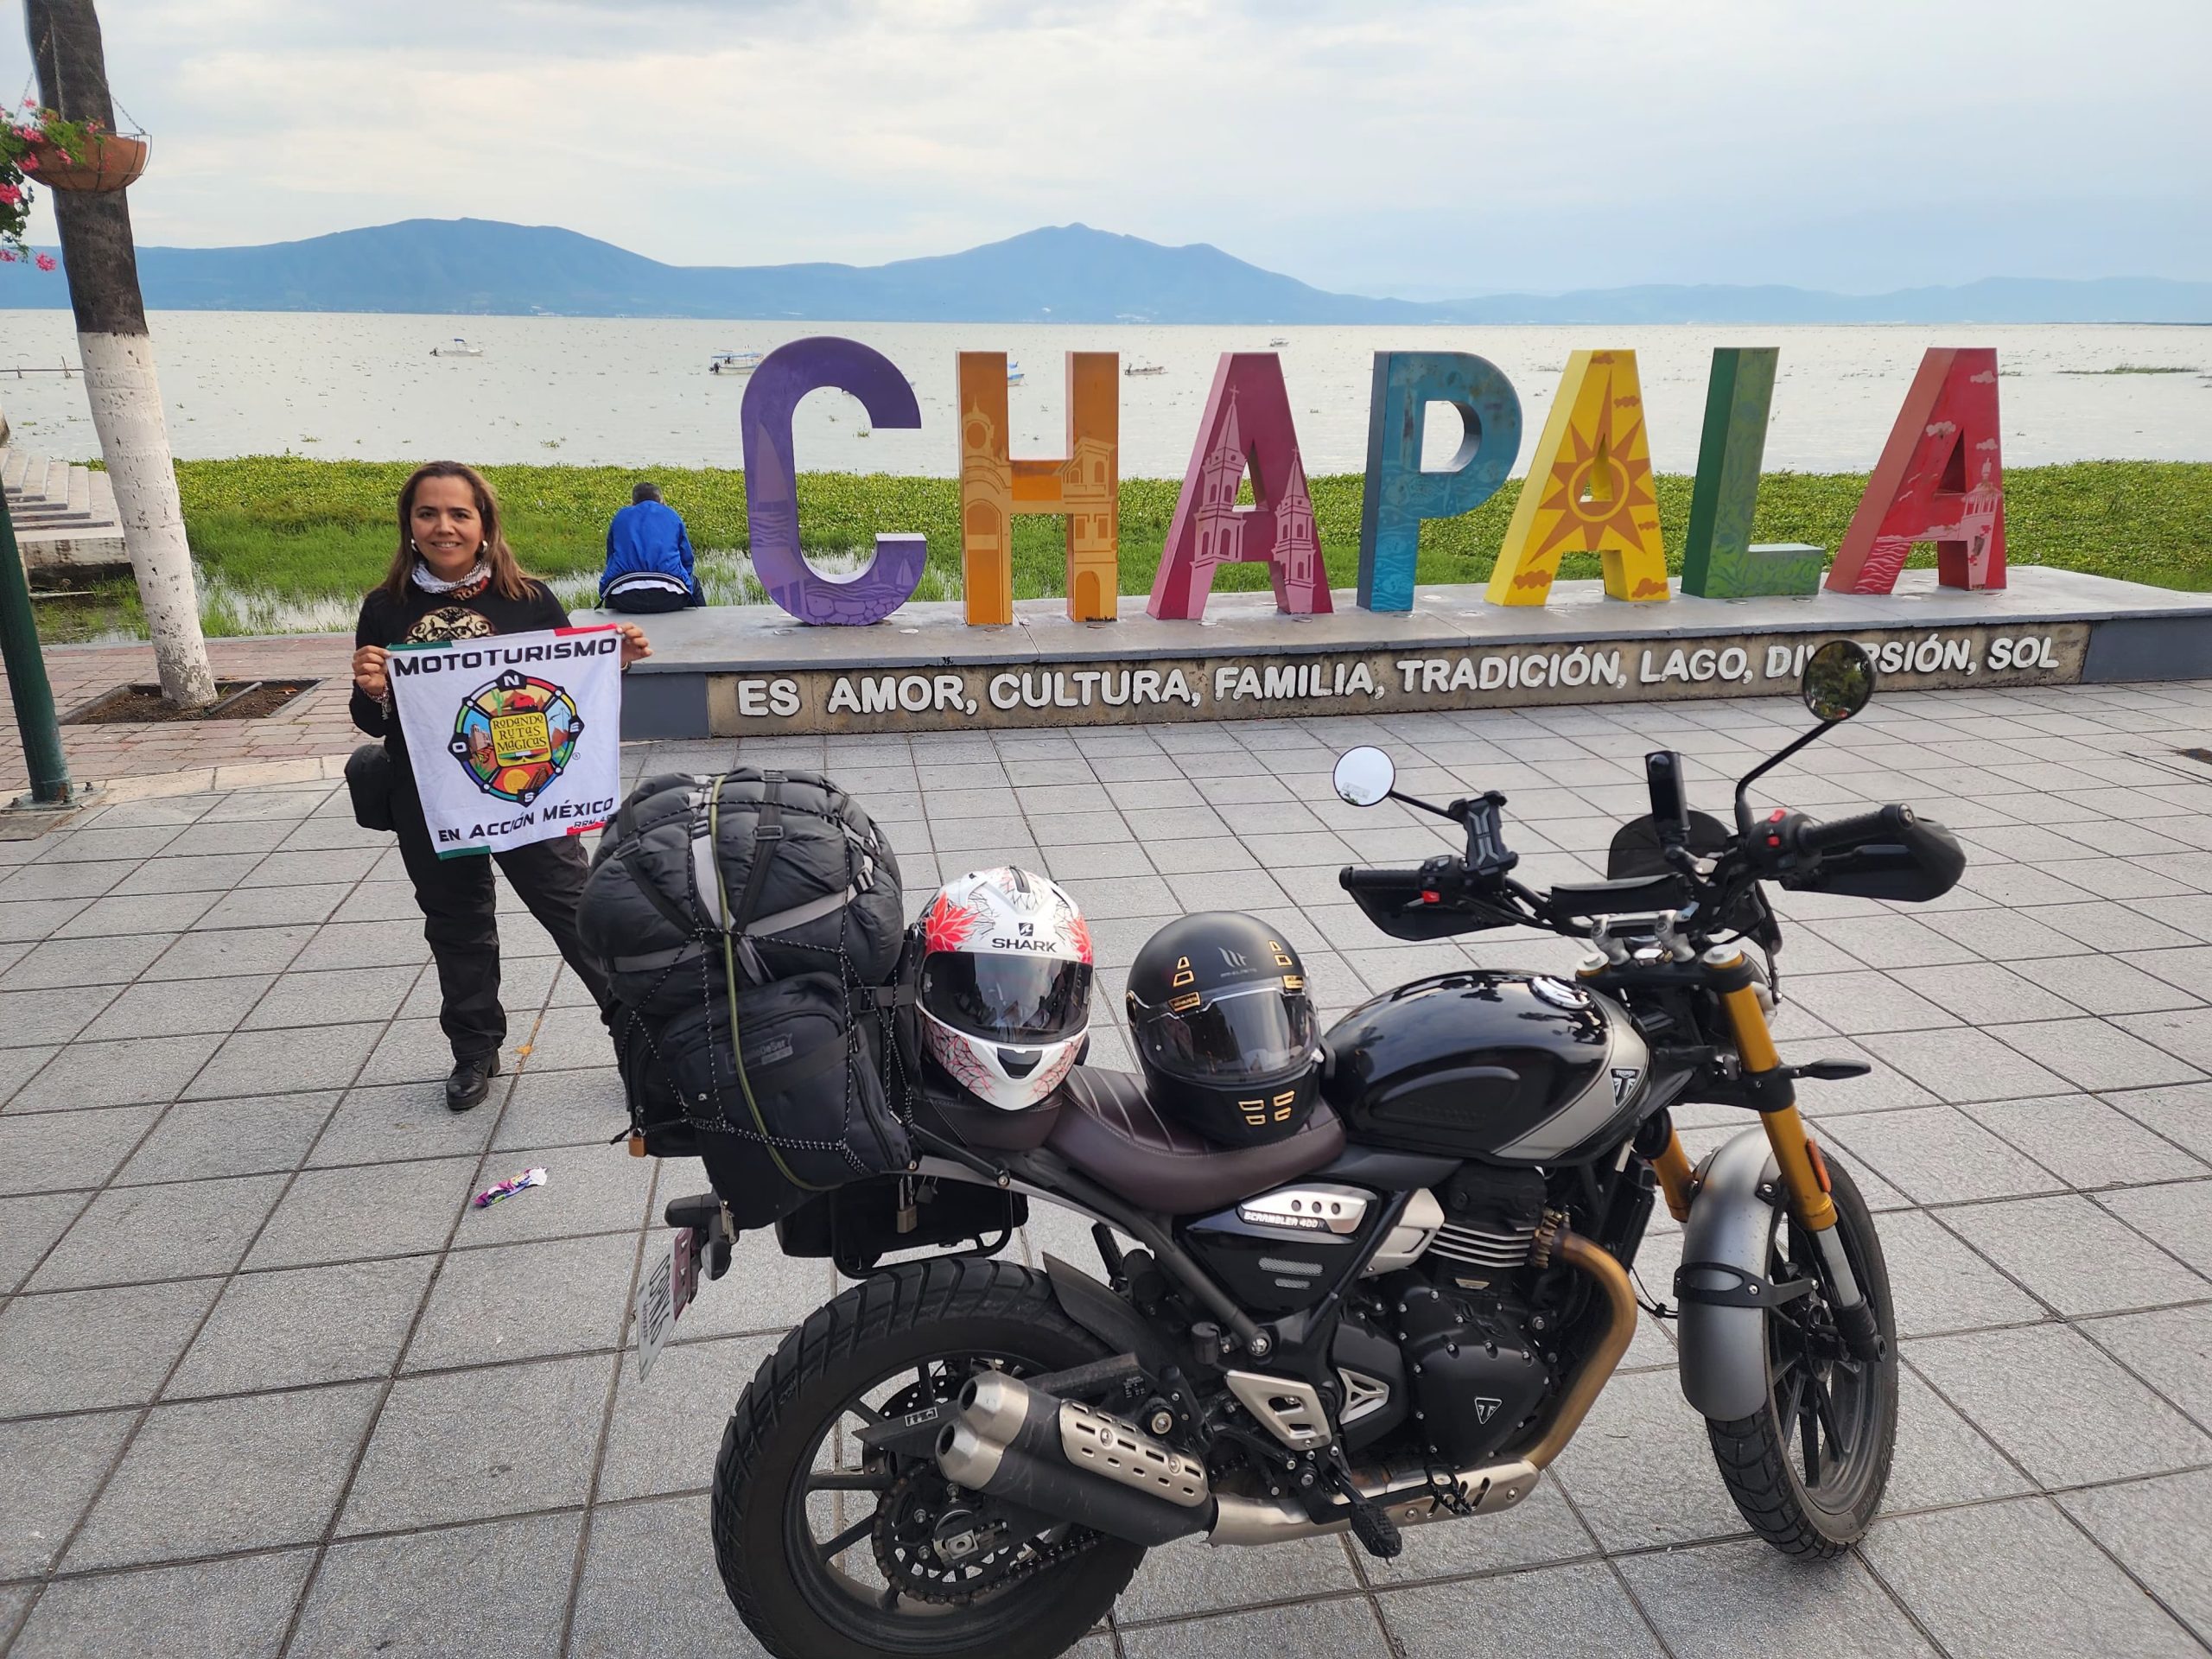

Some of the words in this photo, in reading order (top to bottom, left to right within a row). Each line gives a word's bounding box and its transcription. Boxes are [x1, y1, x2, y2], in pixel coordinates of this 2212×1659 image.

[741, 335, 2007, 626] CHAPALA
[394, 638, 617, 677] MOTOTURISMO
[503, 675, 519, 686] N
[738, 678, 800, 717] ES
[828, 674, 978, 716] AMOR,
[989, 669, 1201, 709] CULTURA,
[1214, 662, 1386, 702] FAMILIA,
[1395, 646, 1628, 693] TRADICIÓN,
[1640, 646, 1754, 686] LAGO,
[1987, 637, 2060, 670] SOL
[570, 723, 580, 732] E
[524, 792, 535, 803] S
[440, 829, 461, 842] EN
[469, 812, 535, 838] ACCIÓN
[543, 798, 613, 823] MÉXICO
[992, 938, 1057, 953] SHARK
[1244, 1211, 1298, 1226] SCRAMBLER
[1300, 1218, 1318, 1228] 400
